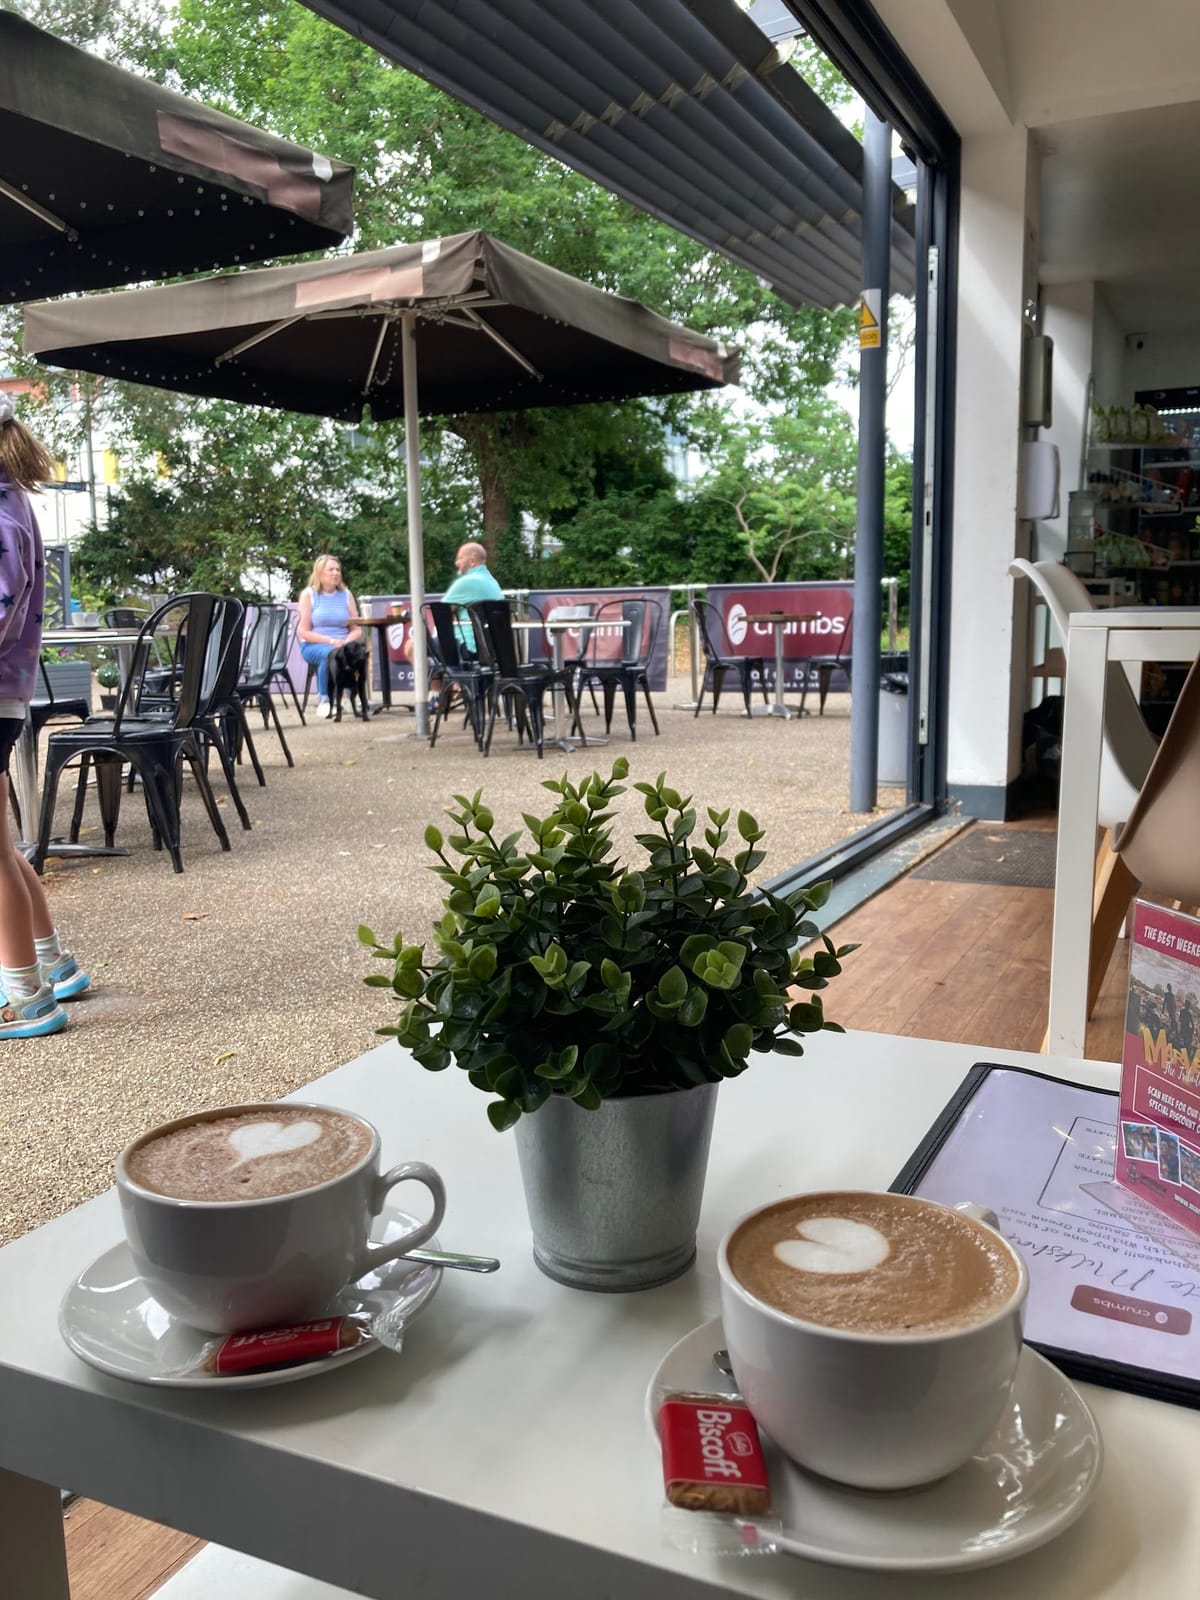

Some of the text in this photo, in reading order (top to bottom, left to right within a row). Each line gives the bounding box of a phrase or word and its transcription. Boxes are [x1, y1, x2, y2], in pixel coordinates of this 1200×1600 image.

[1144, 925, 1158, 941] THE
[1157, 930, 1176, 948] BEST
[1147, 1086, 1199, 1119] SCAN HERE FOR OUR
[1149, 1099, 1169, 1116] SPECIAL
[1169, 1110, 1197, 1131] DISCOUNT
[1031, 1215, 1072, 1231] Cream
[1042, 1226, 1058, 1236] of
[1088, 1222, 1130, 1238] Sauce
[1063, 1232, 1089, 1243] one
[1077, 1227, 1137, 1248] Whipped
[1093, 1240, 1119, 1253] Any
[1093, 1297, 1150, 1317] crumbs
[697, 1409, 742, 1478] Biscoff
